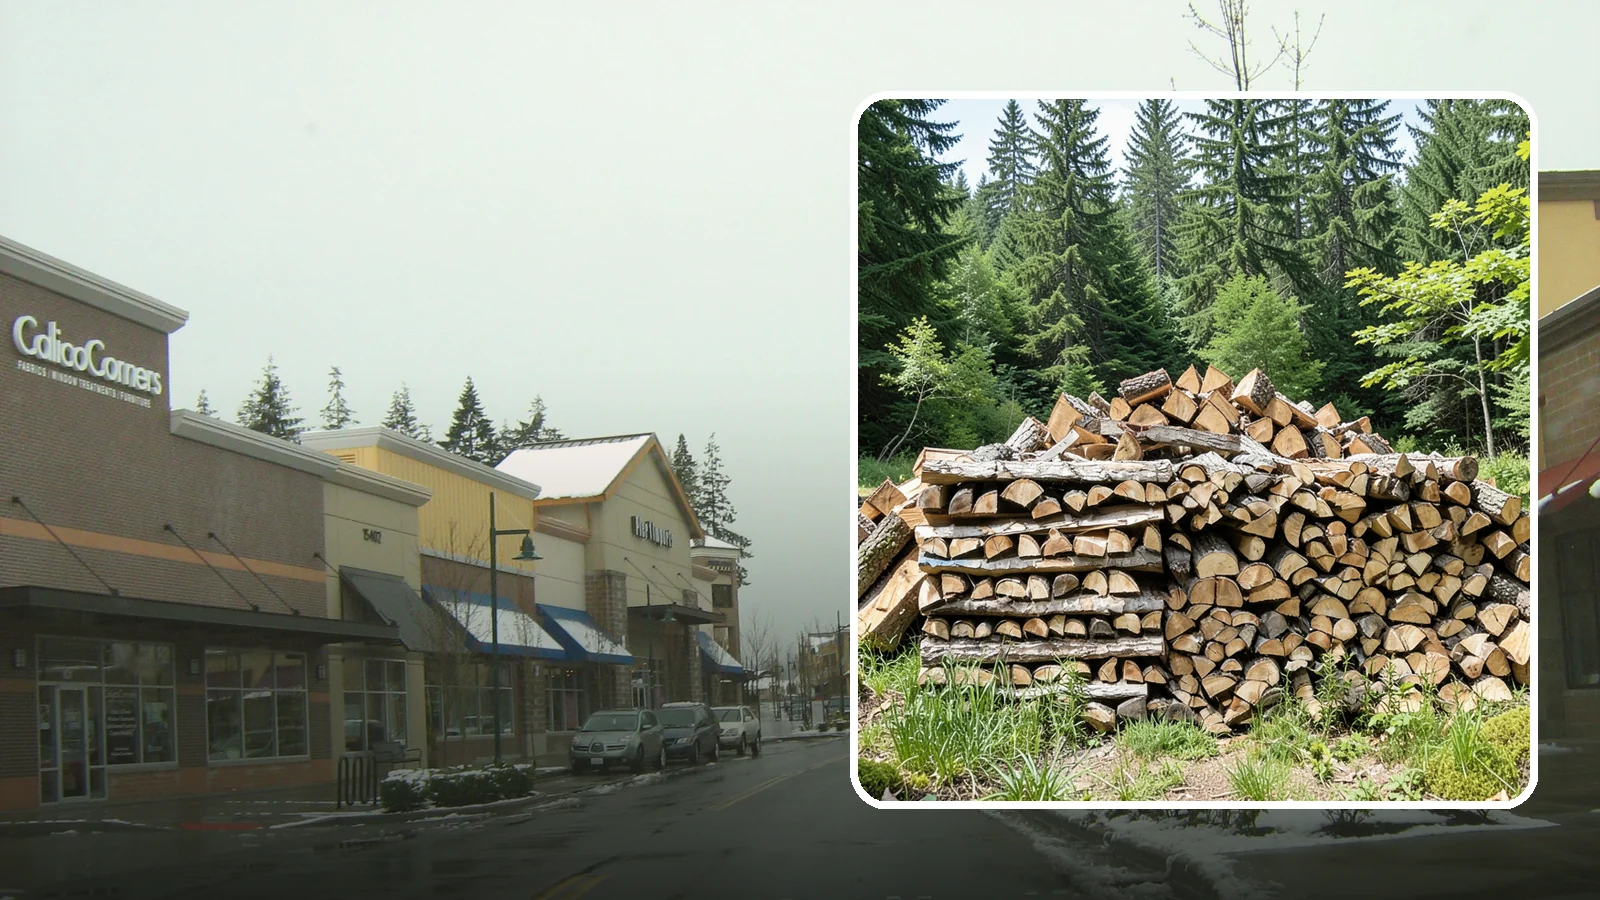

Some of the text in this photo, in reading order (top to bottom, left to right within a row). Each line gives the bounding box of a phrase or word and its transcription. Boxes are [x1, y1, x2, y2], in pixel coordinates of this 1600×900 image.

[17, 360, 47, 378] FABRICS
[51, 370, 78, 387] WINDOW
[78, 378, 116, 398] TREATMENTS
